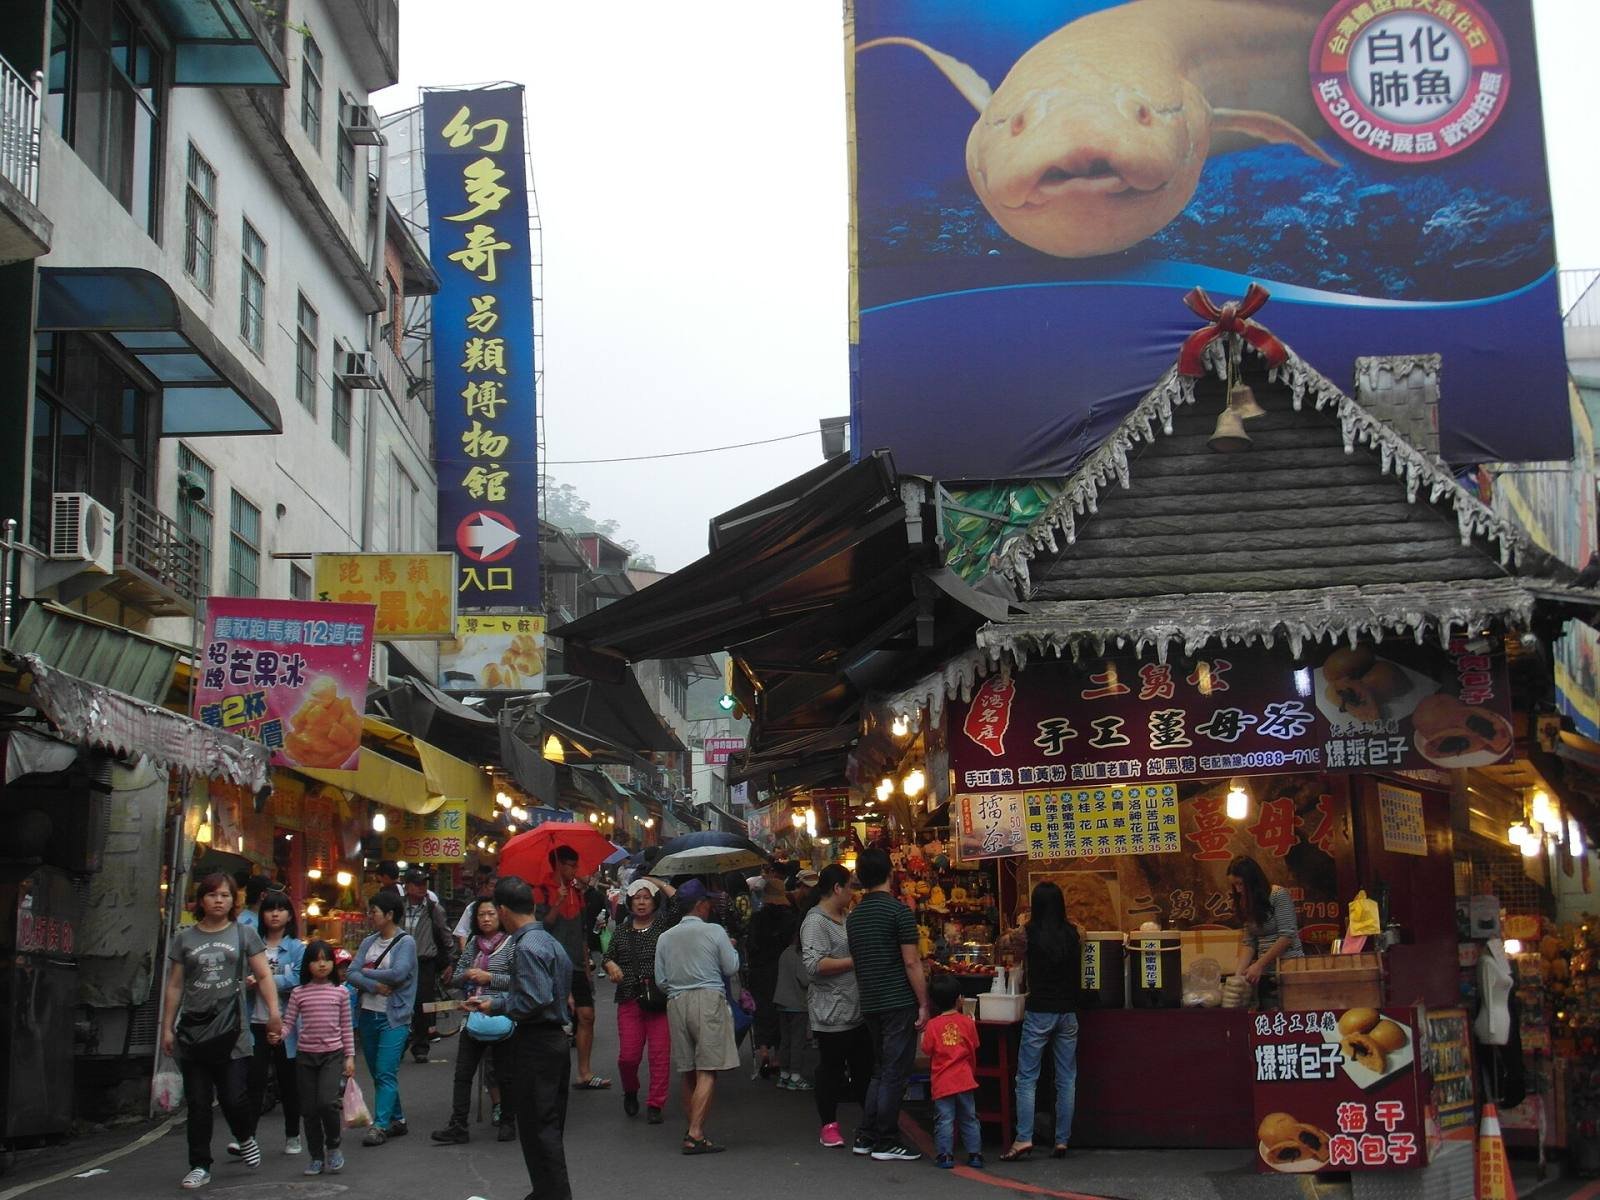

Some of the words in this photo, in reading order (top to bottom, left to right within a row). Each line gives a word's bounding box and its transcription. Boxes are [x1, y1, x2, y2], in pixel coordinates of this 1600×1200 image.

[1367, 26, 1450, 65] 白化
[1369, 68, 1452, 107] 肺魚
[1318, 78, 1437, 153] 近300件展品
[1439, 71, 1502, 146] 歡迎拍照
[441, 105, 513, 282] 幻多奇
[459, 295, 510, 503] 另類博物館
[458, 568, 513, 592] 入口
[337, 588, 450, 633] 果冰
[456, 619, 532, 635] 灣一口酥
[203, 642, 228, 690] 招牌
[229, 649, 307, 689] 芒果冰
[1034, 700, 1315, 757] 手工薑母茶
[1147, 756, 1197, 777] 純黑糖
[1324, 736, 1409, 768] 爆漿包子
[1078, 803, 1093, 847] 桂花茶
[1094, 802, 1110, 846] 冬瓜茶
[1112, 801, 1126, 846] 青草茶
[1128, 799, 1143, 844] 洛神花茶
[1145, 800, 1160, 843] 山苦瓜茶
[1161, 797, 1177, 842] 冷泡茶
[1032, 851, 1044, 859] 30
[1048, 850, 1061, 858] 30
[1065, 849, 1077, 857] 30
[1081, 848, 1093, 856] 30
[1099, 847, 1111, 855] 30
[1115, 846, 1127, 854] 35
[1132, 845, 1144, 853] 35
[1148, 844, 1160, 852] 35
[1165, 843, 1177, 851] 35
[1255, 1012, 1337, 1036] 純手工黑糖
[1255, 1043, 1345, 1081] 爆漿包子
[1337, 1100, 1404, 1133] 梅干
[1329, 1133, 1417, 1166] 肉包子
